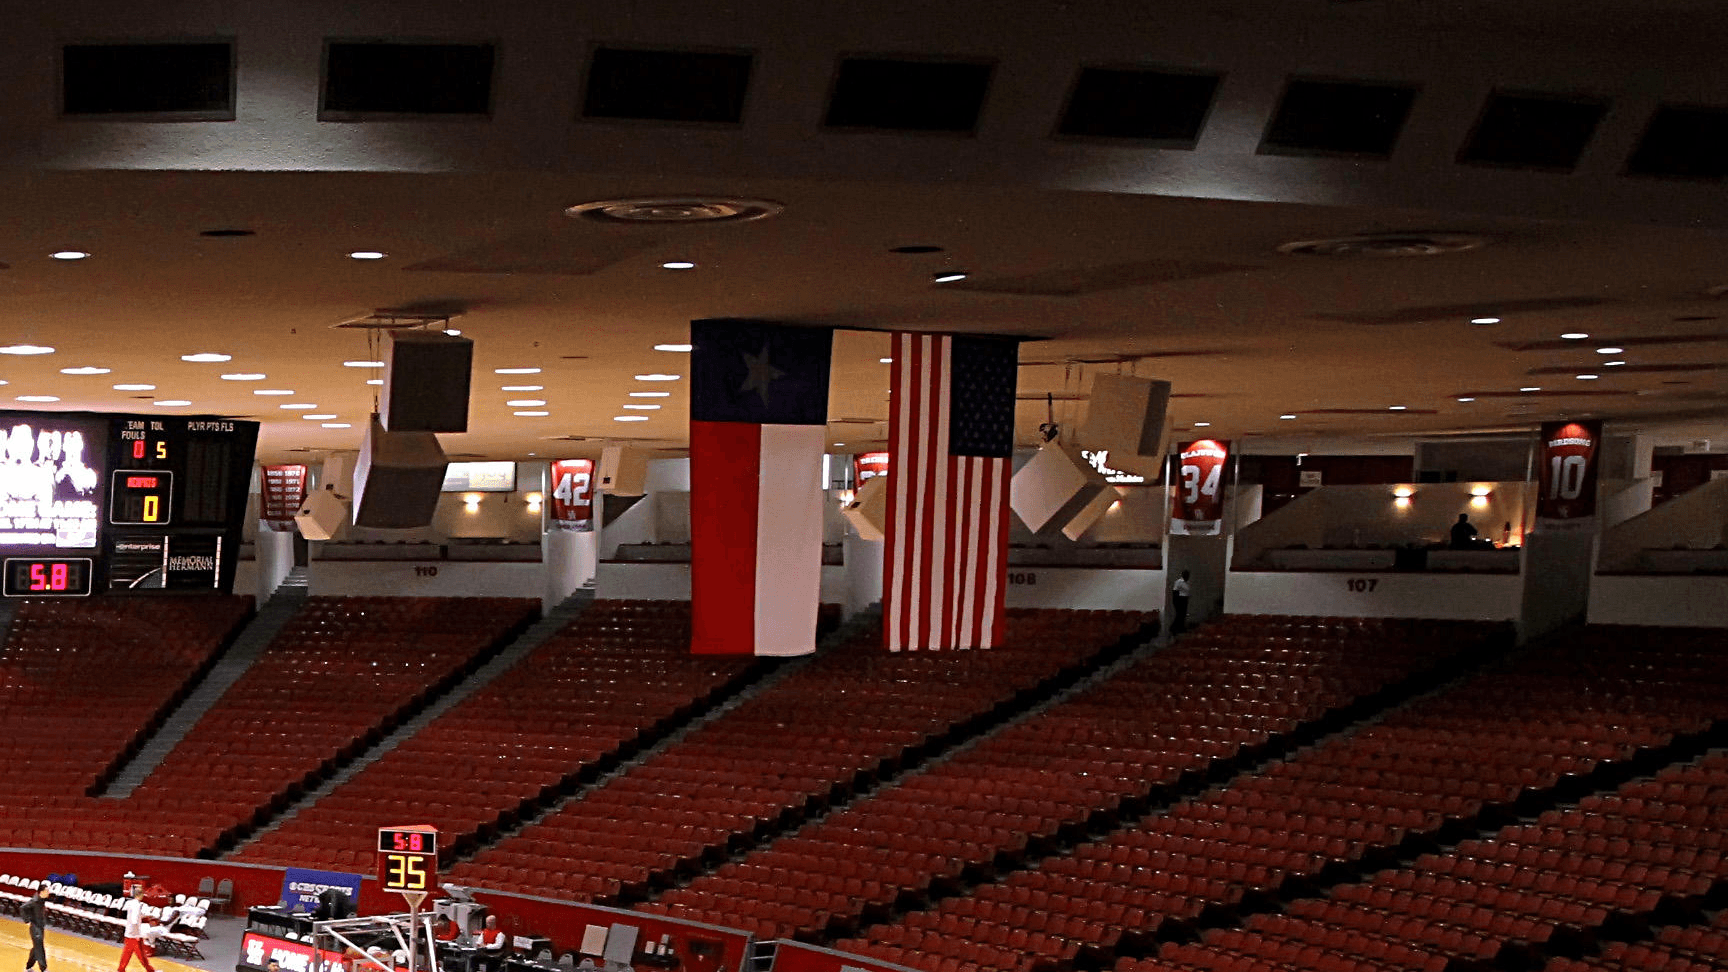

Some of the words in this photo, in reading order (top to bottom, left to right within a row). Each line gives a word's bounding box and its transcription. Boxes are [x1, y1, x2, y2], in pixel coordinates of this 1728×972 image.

[125, 421, 144, 430] TEAM
[151, 421, 164, 430] TOL
[188, 421, 205, 431] PLYR
[206, 422, 220, 431] PTS
[221, 423, 234, 432] FLS
[122, 431, 145, 440] FOULS
[133, 440, 144, 458] 0
[156, 441, 167, 459] 5
[1181, 464, 1222, 504] 34
[1550, 455, 1586, 500] 10
[553, 472, 590, 506] 42
[143, 496, 159, 521] 0
[415, 566, 438, 576] 110
[1347, 578, 1378, 592] 107
[388, 855, 425, 889] 35
